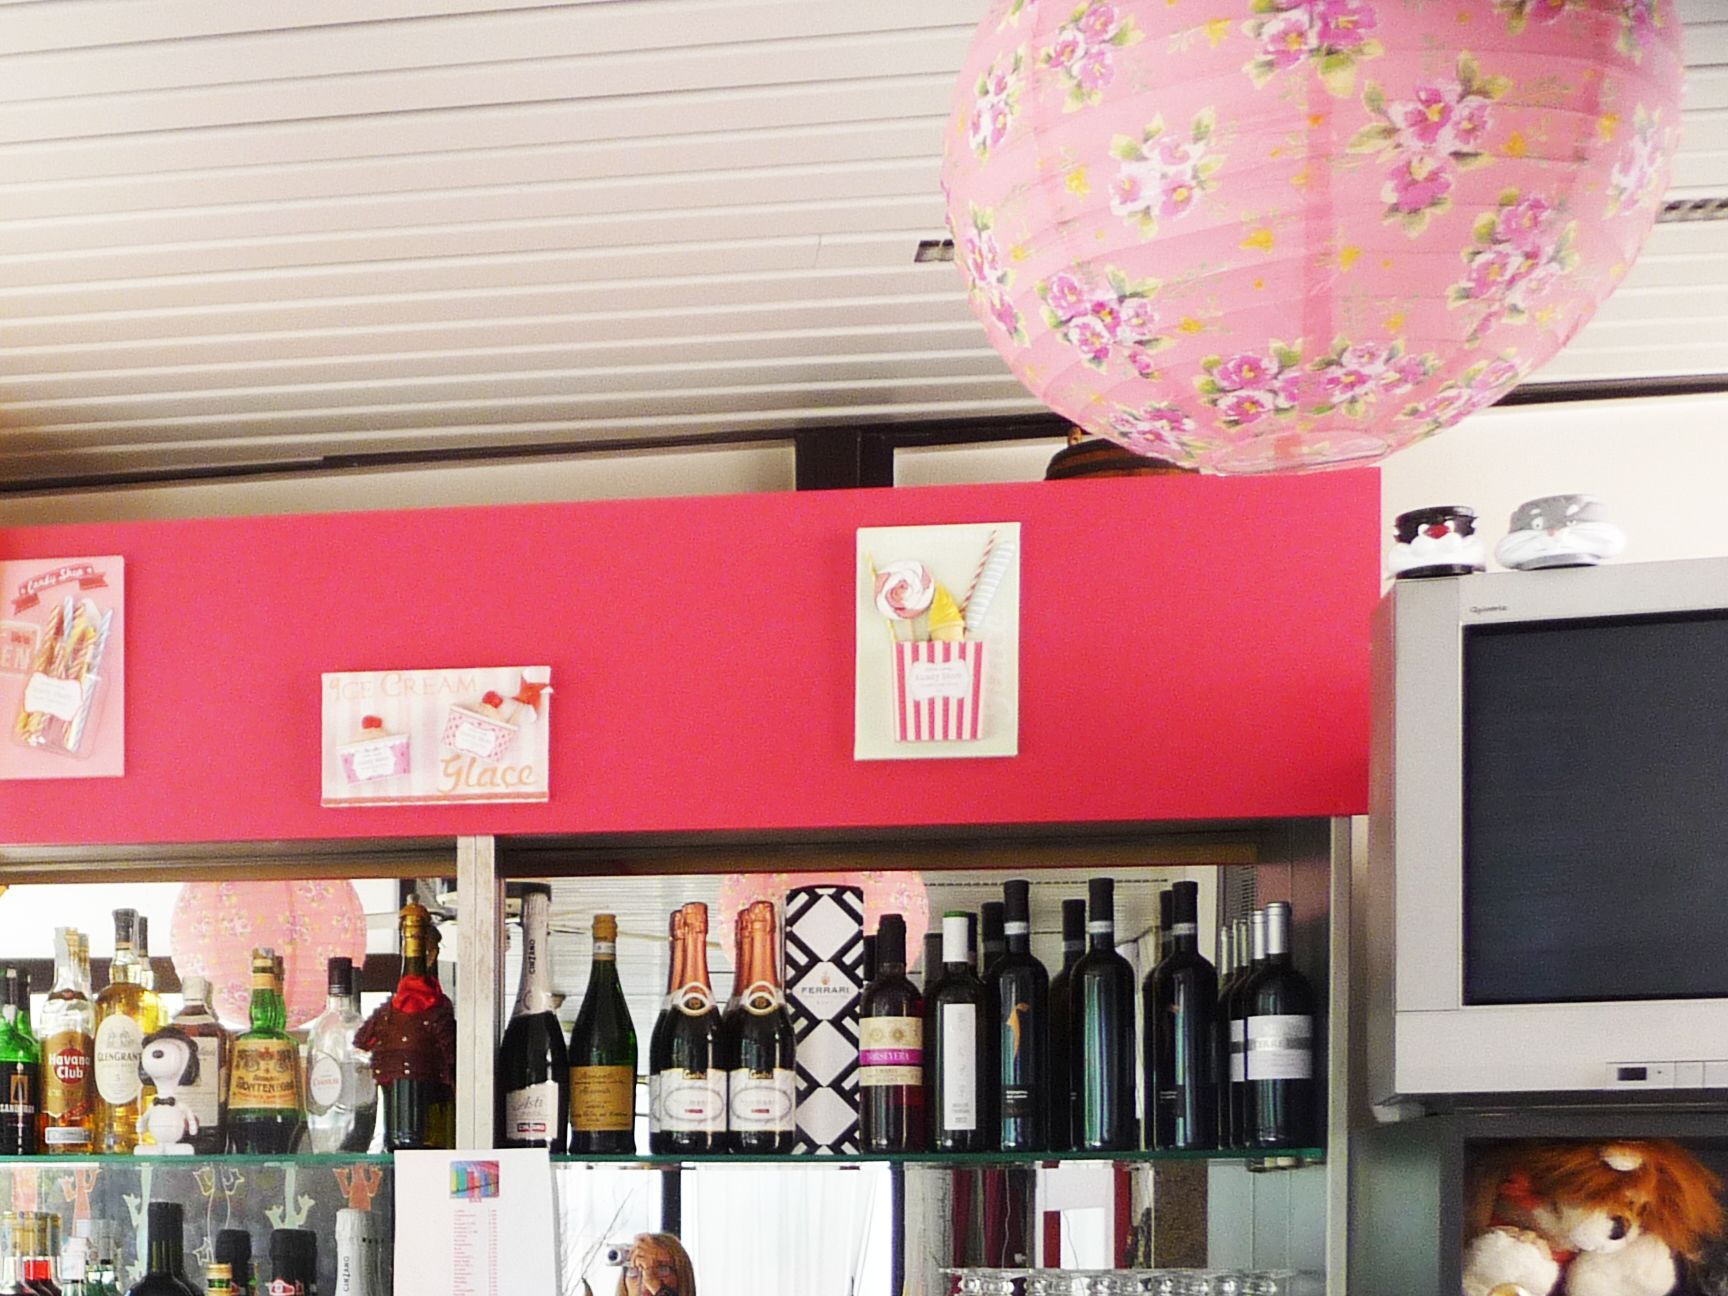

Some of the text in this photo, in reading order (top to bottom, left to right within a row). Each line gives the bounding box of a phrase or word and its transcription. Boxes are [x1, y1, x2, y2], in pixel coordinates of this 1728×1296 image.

[380, 671, 478, 697] CREAM
[801, 986, 851, 995] FERRARI
[48, 1053, 91, 1066] Havana
[56, 1065, 84, 1080] Club
